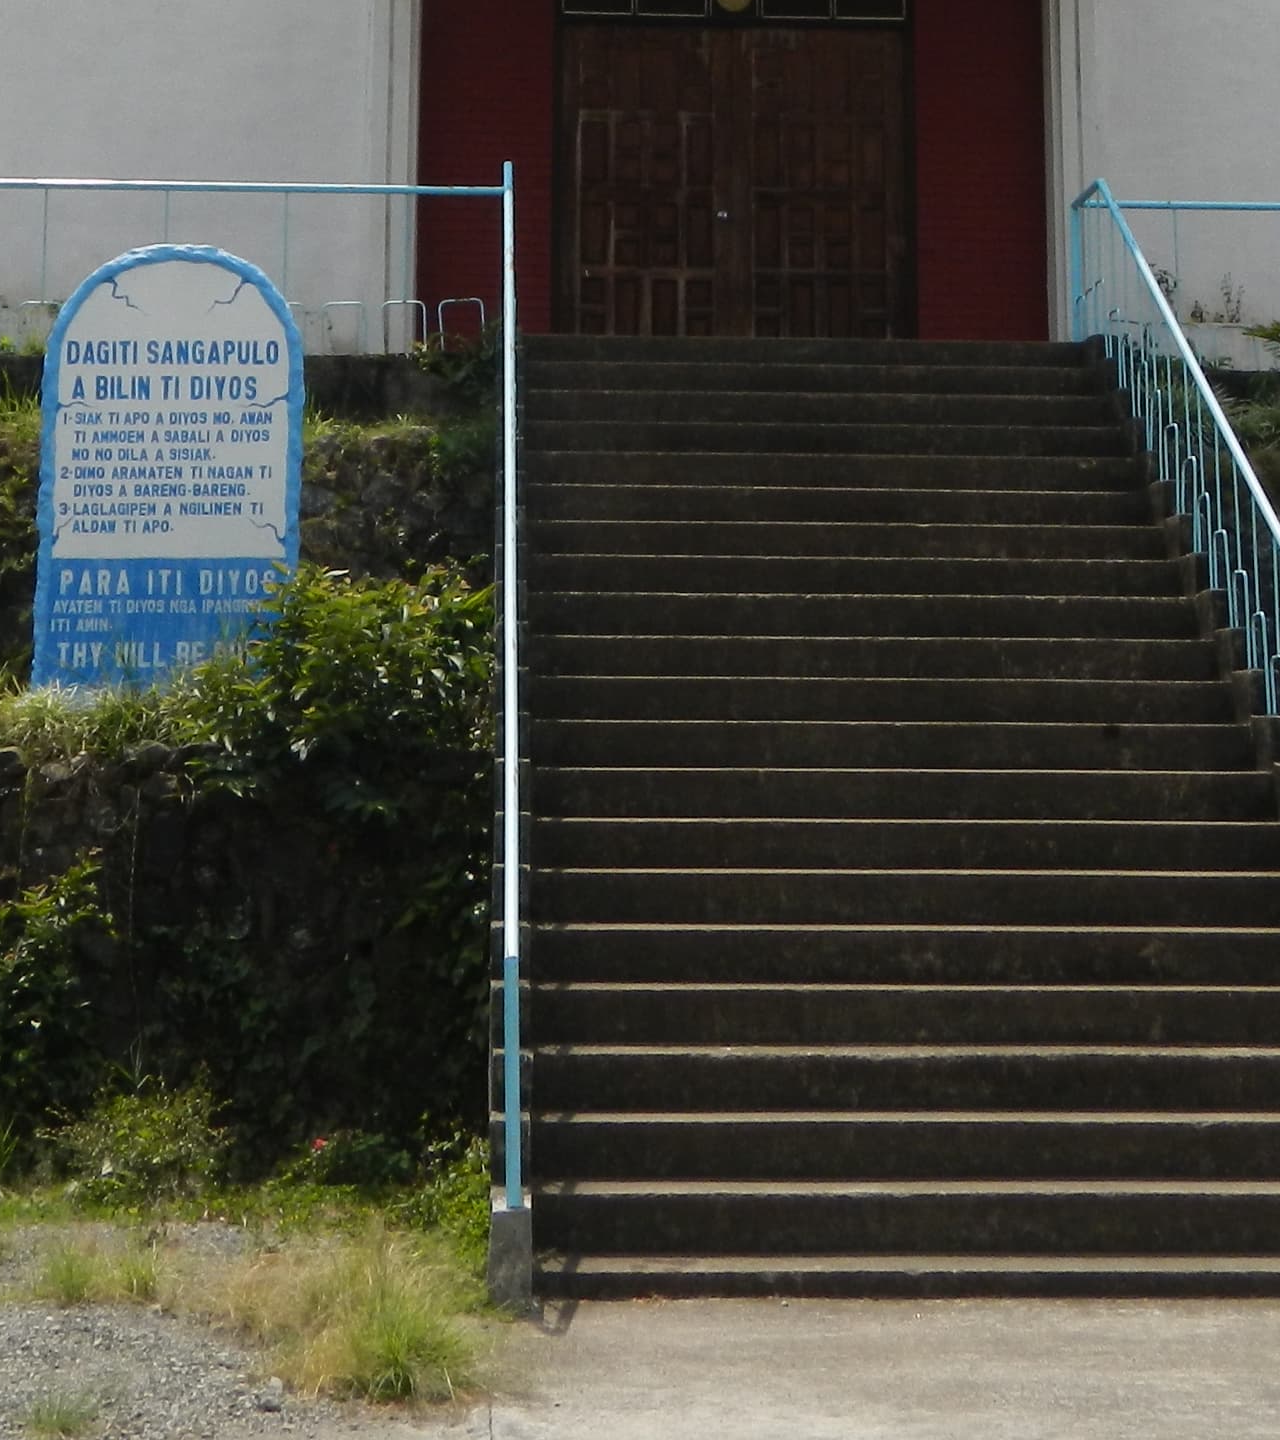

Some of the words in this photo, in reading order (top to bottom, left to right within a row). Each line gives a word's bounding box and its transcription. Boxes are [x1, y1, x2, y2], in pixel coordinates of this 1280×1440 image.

[66, 341, 138, 365] DAGITI
[146, 341, 279, 365] SANGAPULO
[72, 376, 85, 400] A
[96, 376, 151, 400] BILIN
[161, 376, 180, 400] TI
[190, 376, 257, 400] DIYOS
[109, 412, 119, 425] TI
[124, 412, 149, 425] APO
[156, 412, 163, 424] A
[169, 412, 207, 425] DIYOS
[240, 412, 273, 425] AWAN
[74, 431, 86, 443] TI
[151, 430, 159, 442] A
[164, 430, 210, 442] SABALI
[216, 430, 224, 442] A
[231, 429, 270, 442] DIYOS
[72, 449, 89, 461] MO
[95, 449, 112, 461] NO
[118, 448, 148, 461] DILA
[155, 448, 163, 461] A
[112, 467, 182, 480] ARAMATEN
[191, 467, 202, 479] TI
[207, 466, 253, 479] NAGAN
[259, 466, 272, 479] TI
[74, 484, 113, 497] DIYOS
[119, 484, 127, 497] A
[164, 503, 172, 516] A
[180, 502, 242, 516] NGILINEN
[251, 502, 264, 515] TI
[72, 520, 116, 533] ALDAW
[124, 520, 136, 533] TI
[60, 569, 131, 595] PARA
[148, 569, 182, 595] ITI
[110, 600, 122, 614] TI
[127, 600, 165, 614] DIYOS
[170, 600, 196, 614] NGA
[51, 619, 70, 633] ITI
[58, 642, 103, 668] THY
